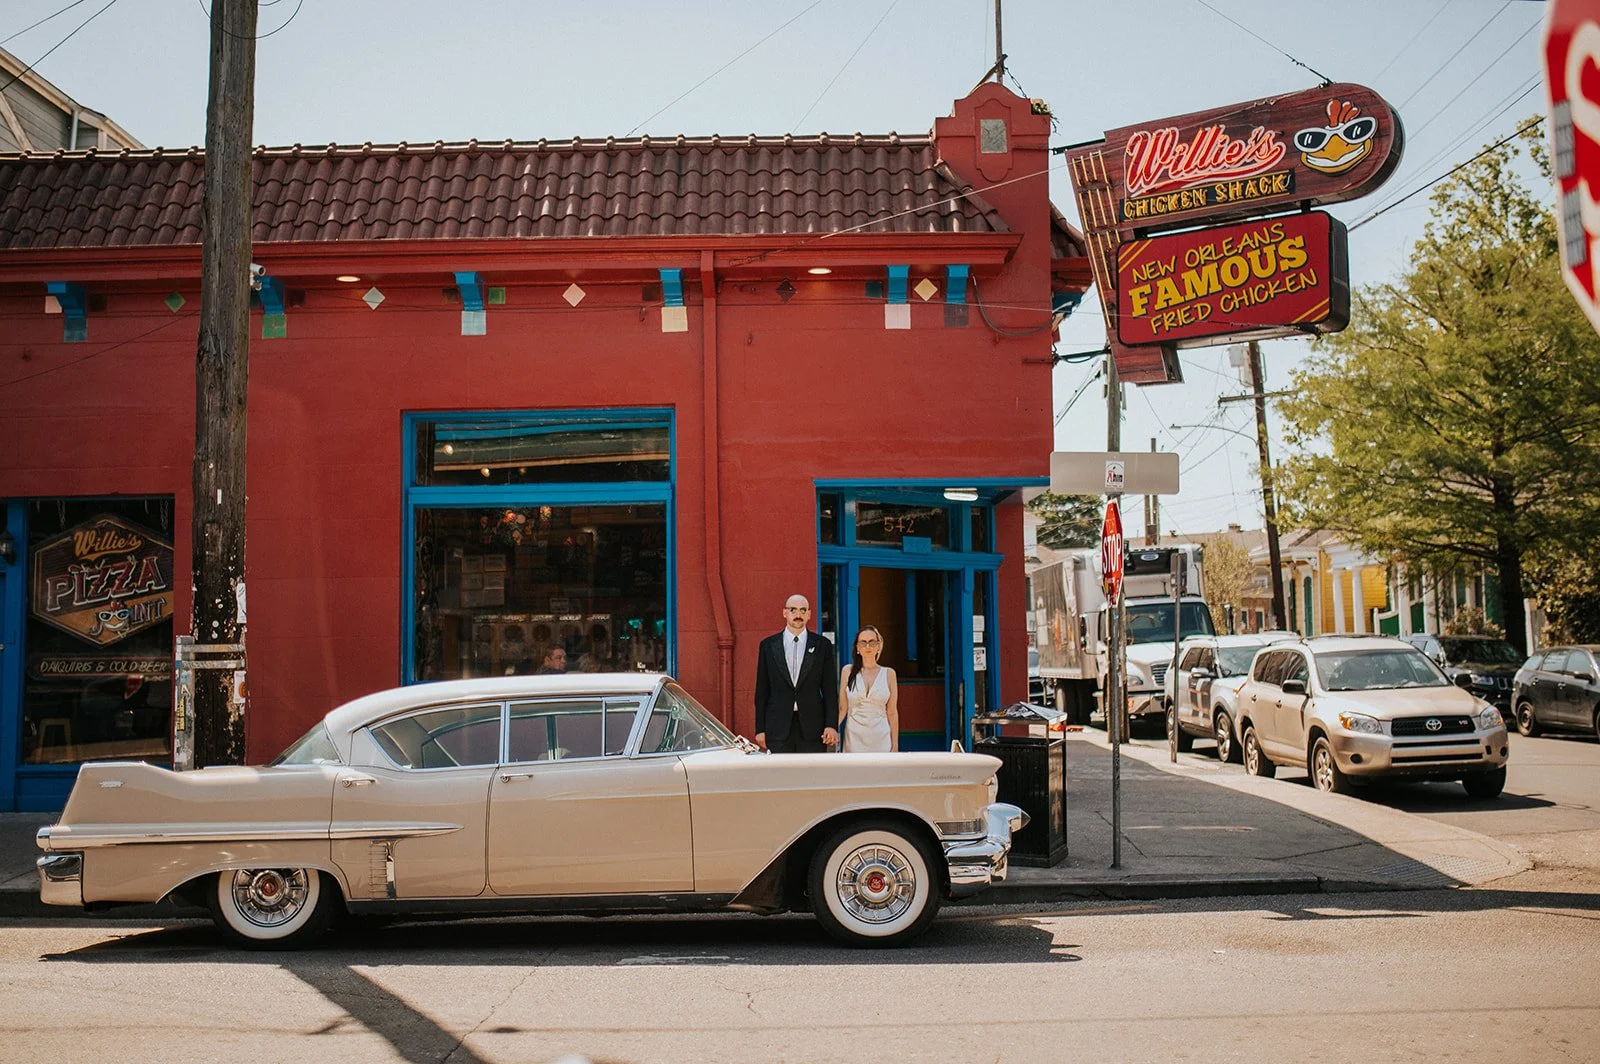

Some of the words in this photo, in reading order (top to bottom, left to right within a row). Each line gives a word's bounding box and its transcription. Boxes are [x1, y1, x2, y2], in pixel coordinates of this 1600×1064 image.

[1126, 125, 1286, 196] Willie's
[1124, 188, 1207, 218] CHICKEN
[1215, 174, 1287, 203] SHACK
[1132, 255, 1177, 284] NEW
[1184, 222, 1286, 268] ORLEANS
[1128, 235, 1308, 318] FAMOUS
[1150, 302, 1213, 335] FRIED
[1220, 268, 1318, 313] CHICKEN
[74, 529, 142, 558] Willie's
[883, 513, 915, 533] 542
[1102, 532, 1121, 574] STOP
[46, 555, 167, 612] PIZZA
[88, 597, 166, 637] JINT
[109, 660, 138, 672] COLD
[139, 661, 168, 673] BEER
